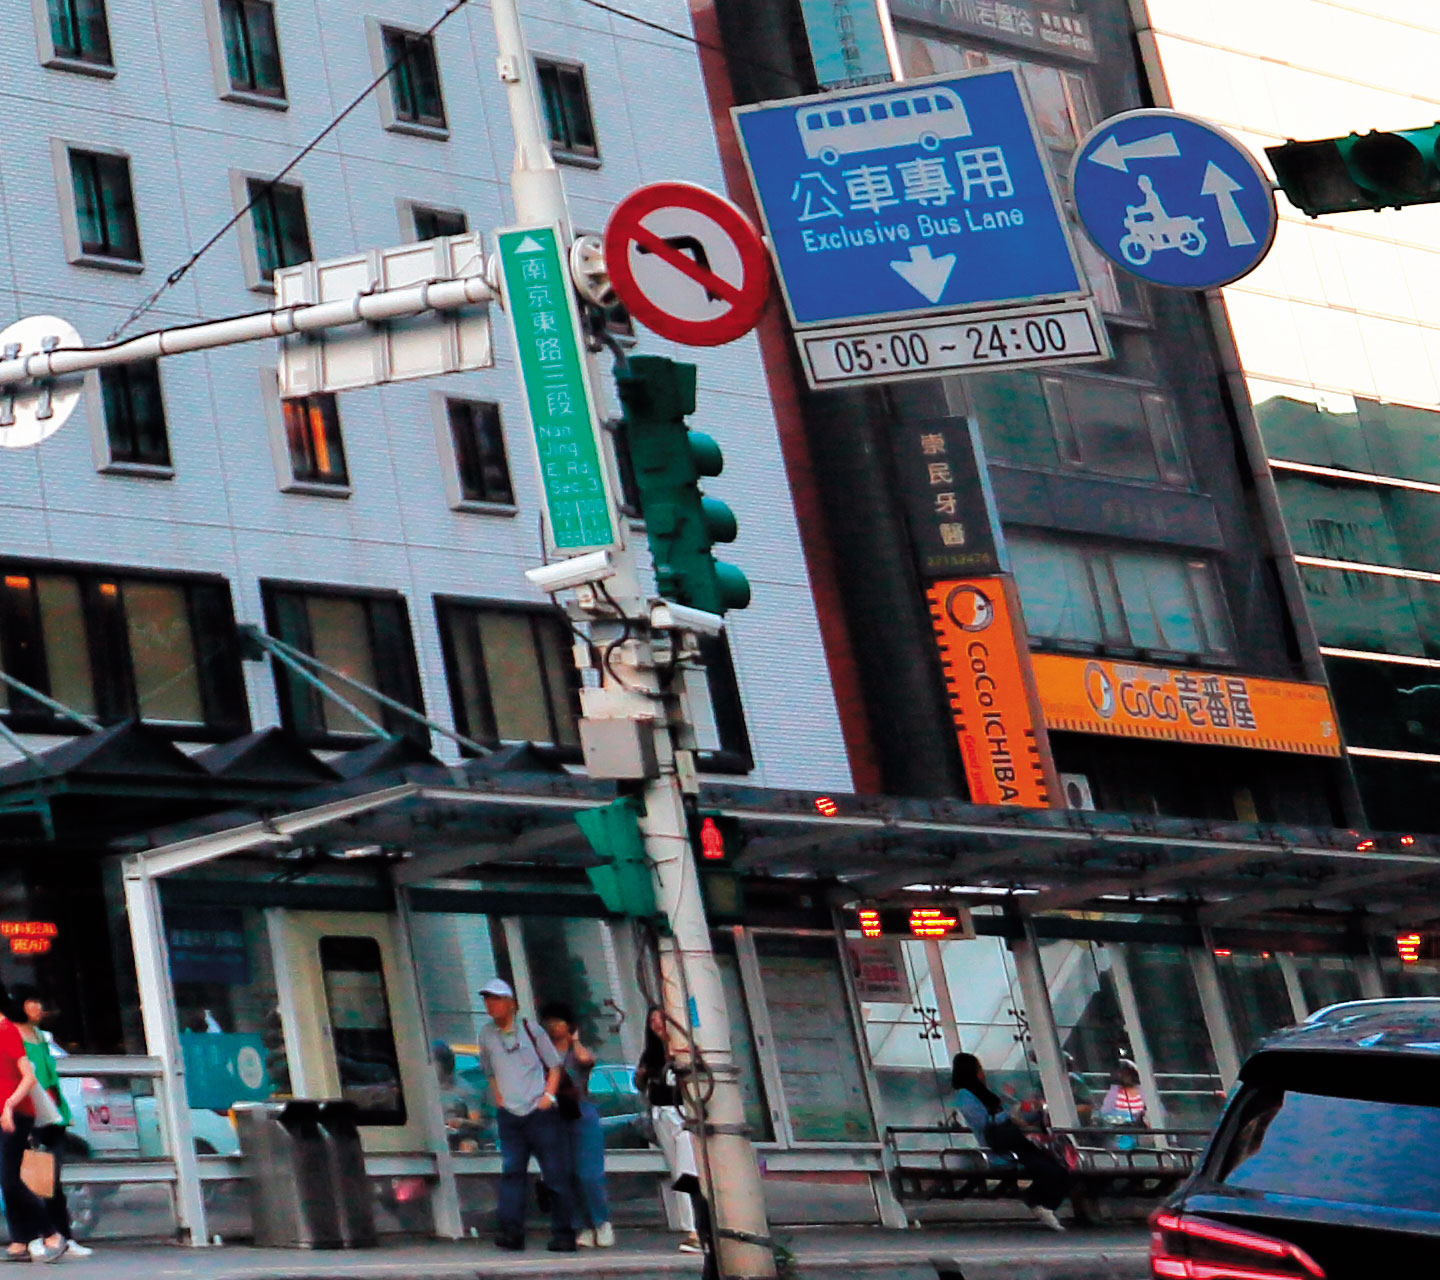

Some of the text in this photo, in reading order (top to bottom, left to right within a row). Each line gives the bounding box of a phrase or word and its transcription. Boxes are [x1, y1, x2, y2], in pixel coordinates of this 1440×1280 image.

[791, 146, 1015, 222] 公車專用
[802, 206, 1025, 255] Exclusive Bus Lane
[521, 258, 575, 418] 南京東路三段
[834, 331, 930, 374] 05:00
[965, 317, 1067, 360] 24:00
[967, 641, 997, 708] CoCo
